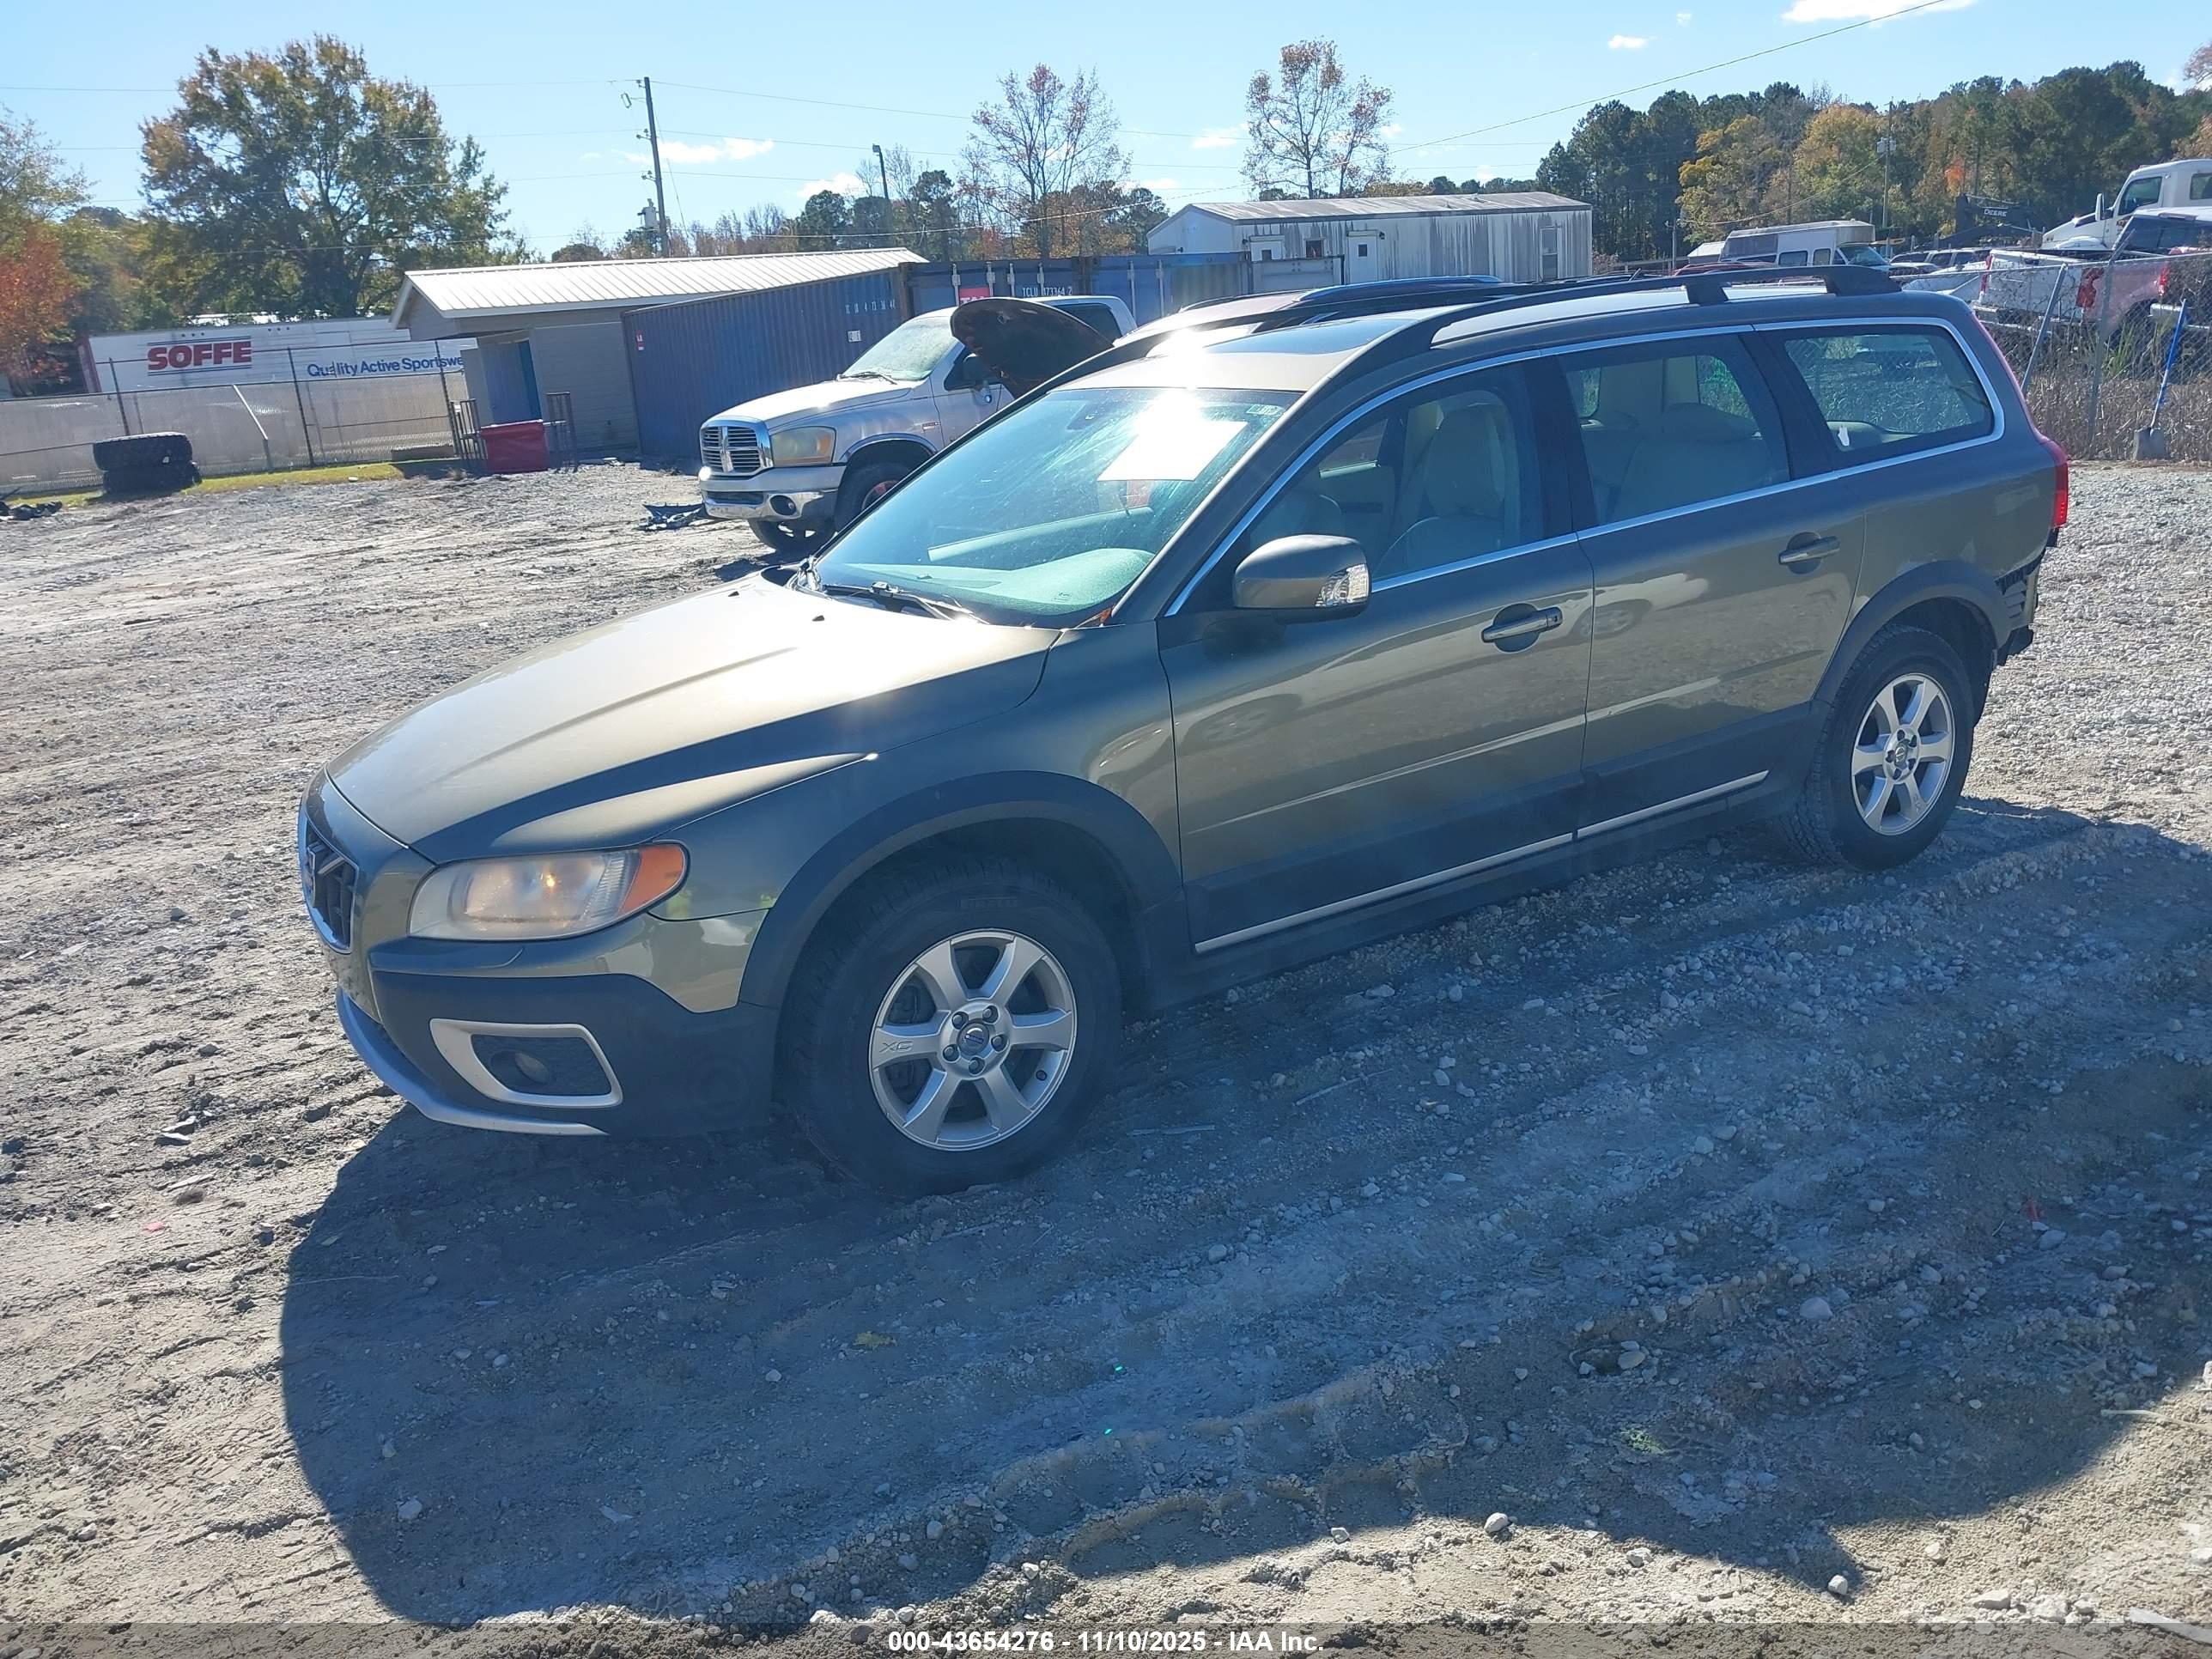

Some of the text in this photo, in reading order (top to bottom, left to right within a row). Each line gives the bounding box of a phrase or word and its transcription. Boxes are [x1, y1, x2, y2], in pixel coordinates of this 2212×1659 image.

[1984, 209, 2008, 217] DEERE
[148, 341, 252, 370] SOFFE
[307, 362, 357, 377] Quality
[361, 359, 400, 374] Active
